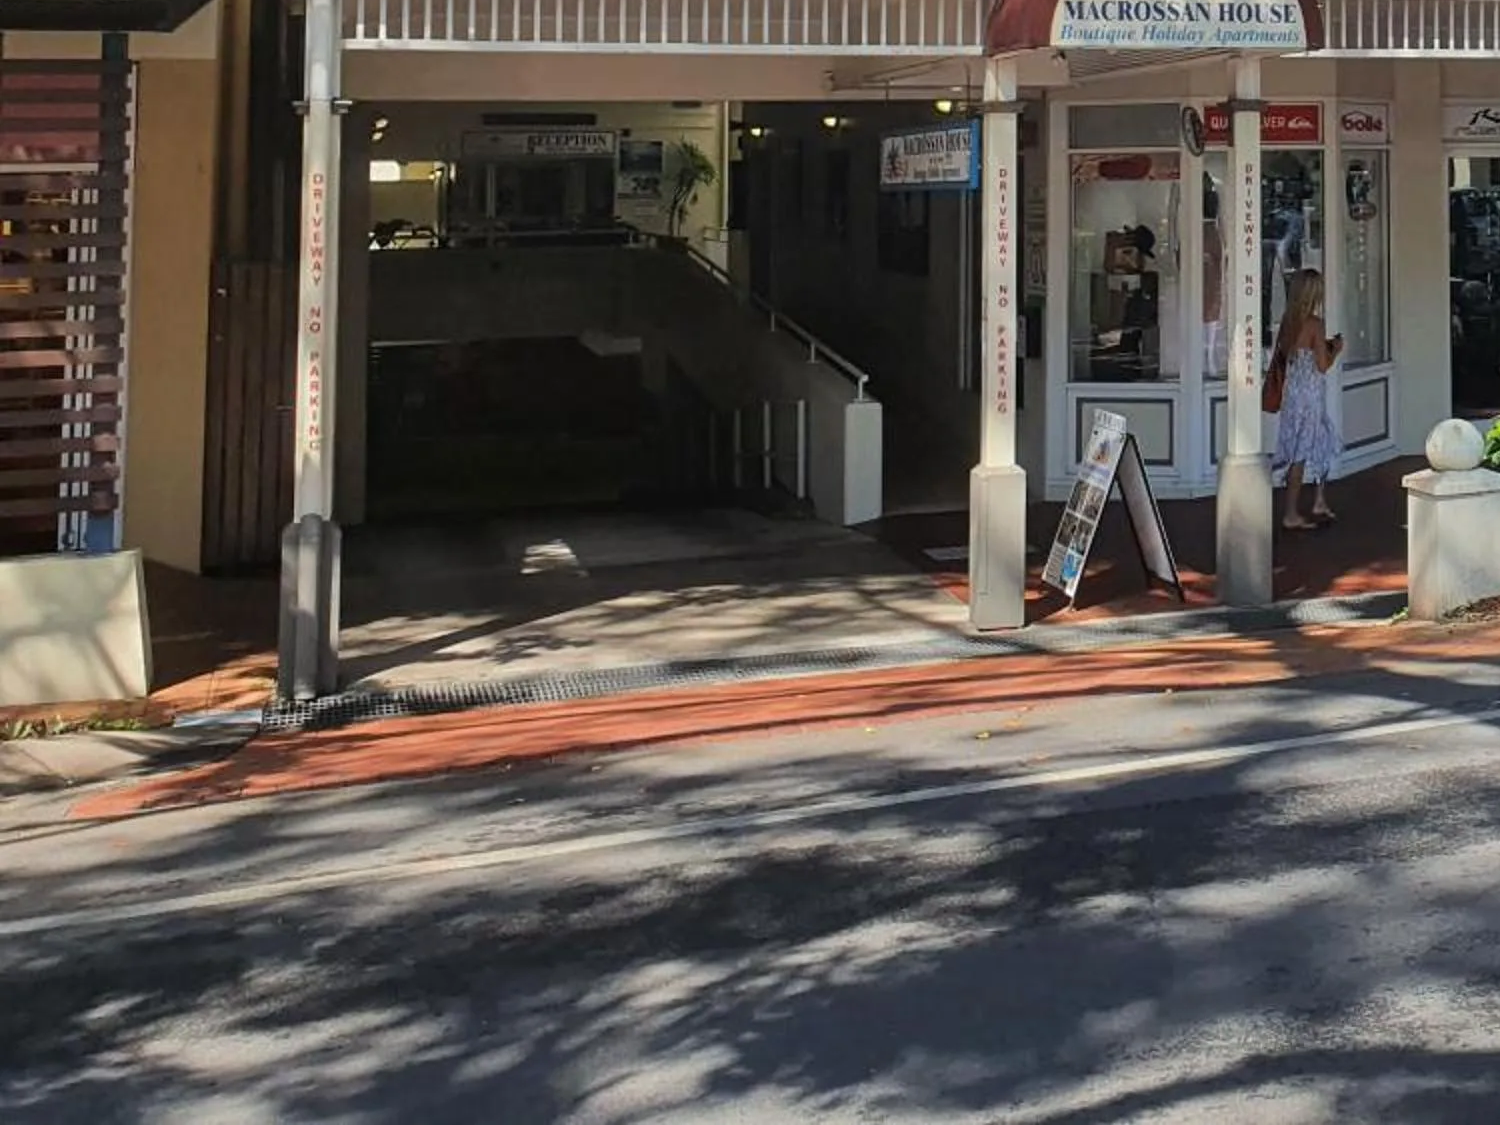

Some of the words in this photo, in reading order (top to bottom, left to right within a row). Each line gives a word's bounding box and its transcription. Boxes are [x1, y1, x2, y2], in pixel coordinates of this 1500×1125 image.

[1060, 24, 1136, 43] Boutique
[1142, 24, 1204, 44] Holiday
[1208, 27, 1300, 44] Apartments
[1064, 0, 1210, 23] MACROSSAN
[1218, 2, 1297, 24] HOUSE
[309, 173, 324, 286] DRIVEWAY
[997, 168, 1009, 267] DRIVEWAY
[1244, 163, 1255, 257] DRIVEWAY
[998, 284, 1008, 308] NO
[1245, 274, 1254, 296] NO
[308, 307, 322, 334] NO
[997, 326, 1008, 414] PARKING
[308, 351, 321, 451] PARKING
